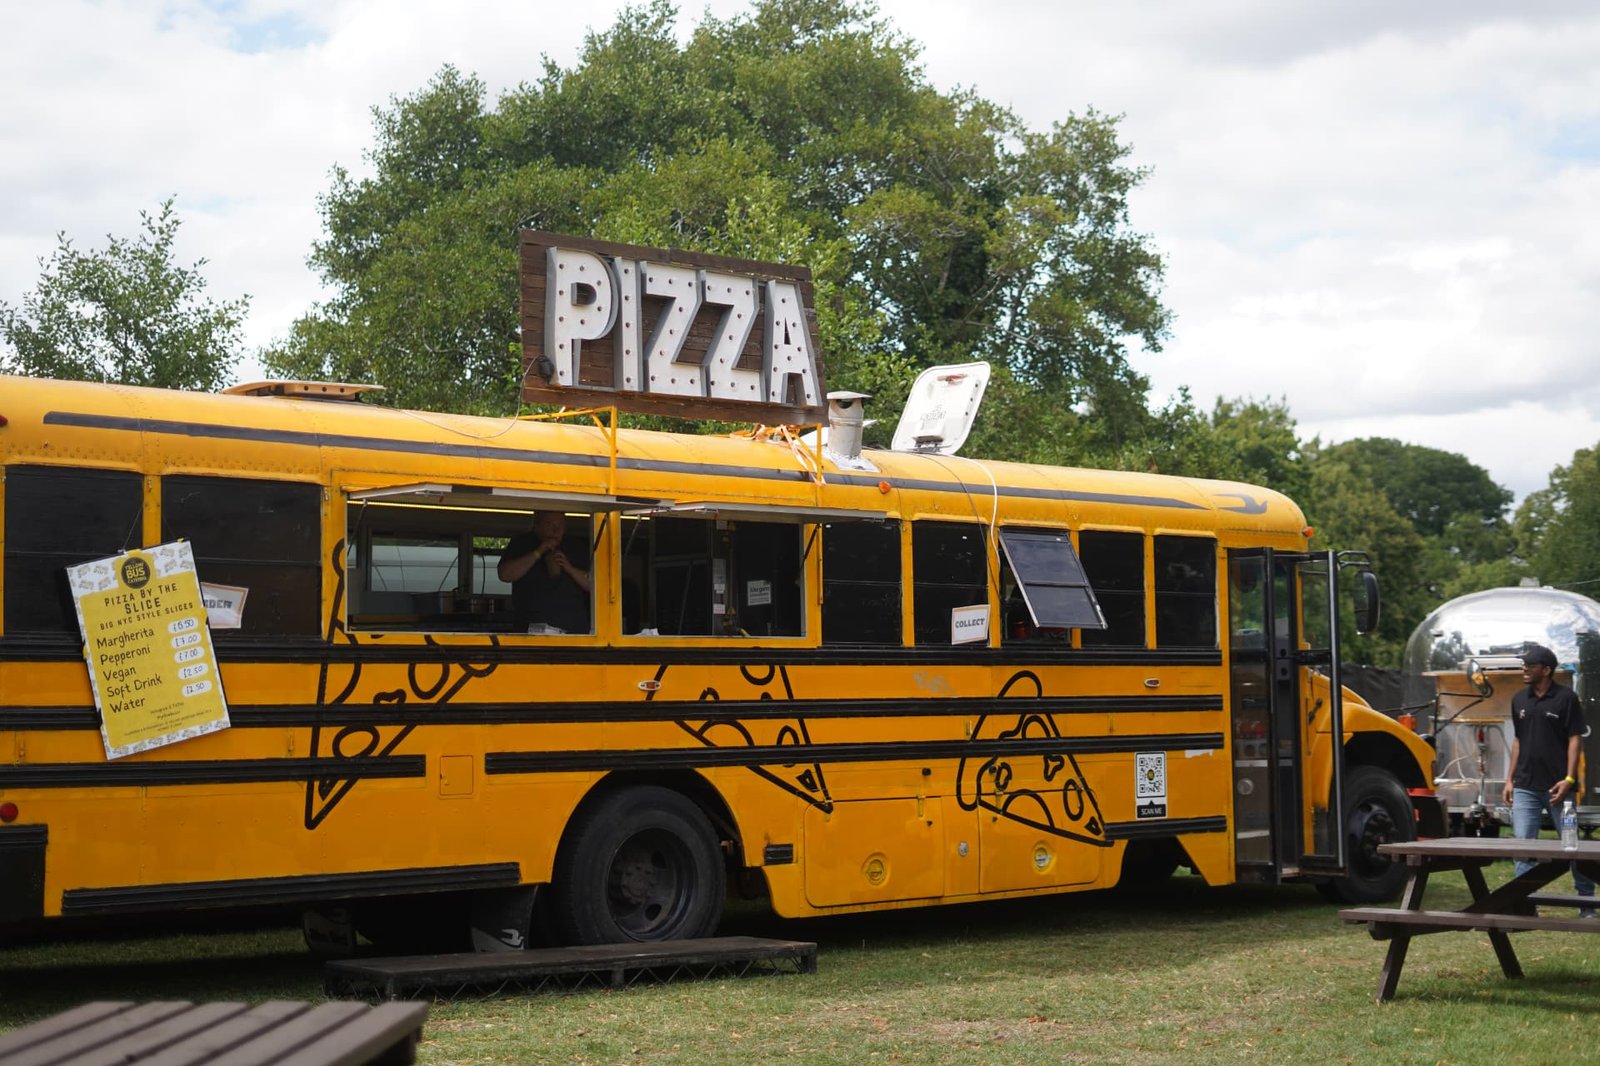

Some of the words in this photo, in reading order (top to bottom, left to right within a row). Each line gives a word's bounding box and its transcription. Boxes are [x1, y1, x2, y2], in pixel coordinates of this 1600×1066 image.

[545, 246, 824, 407] PIZZA
[126, 567, 145, 579] BUS
[104, 593, 136, 607] PIZZA
[140, 587, 153, 599] BY
[158, 582, 178, 594] THE
[100, 620, 114, 631] BIG
[117, 617, 133, 628] NYC
[136, 611, 162, 623] STYLE
[164, 602, 194, 615] SLICES
[124, 597, 162, 615] SLICE
[956, 618, 985, 628] COLLECT
[96, 628, 155, 649] Margherita
[100, 645, 151, 666] Pepperoni
[103, 665, 137, 682] Vegan
[106, 685, 131, 698] Soft
[134, 674, 163, 690] Drink
[109, 696, 146, 714] Water
